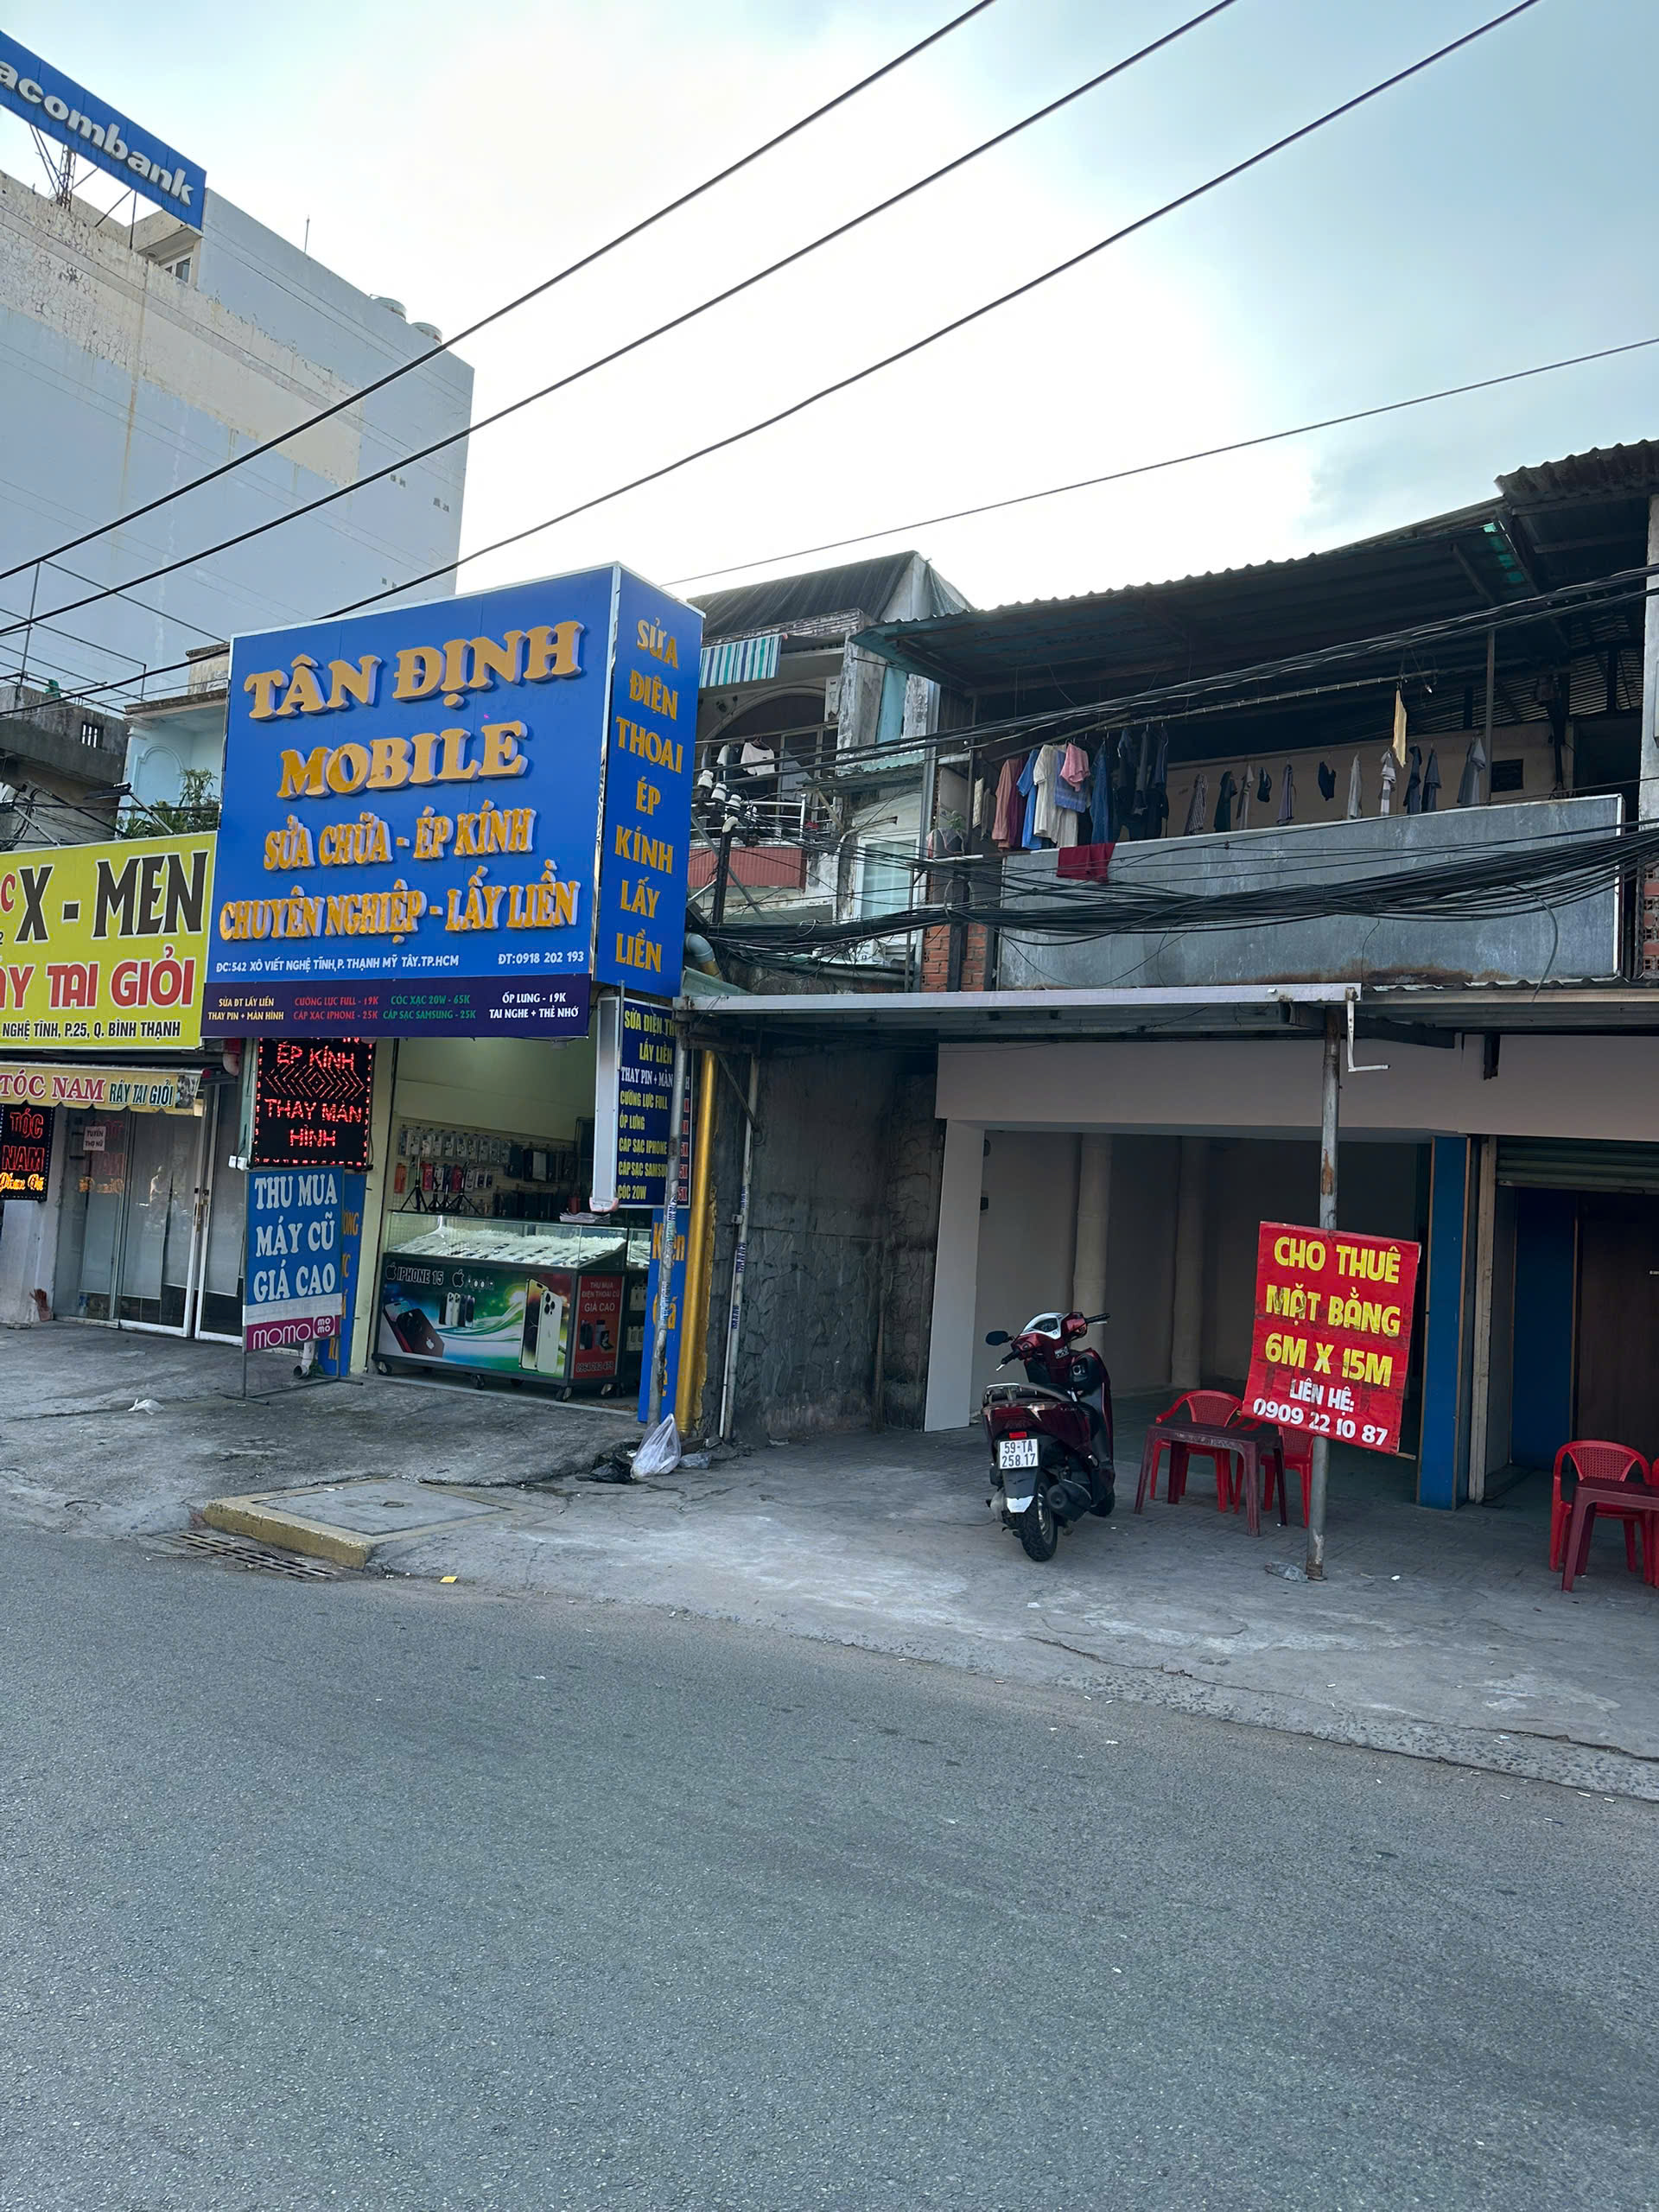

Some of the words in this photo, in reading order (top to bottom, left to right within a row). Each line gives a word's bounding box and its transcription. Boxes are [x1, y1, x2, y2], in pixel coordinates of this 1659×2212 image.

[637, 617, 678, 670] SỬA
[244, 653, 382, 721] TÂN
[392, 620, 585, 709] ĐỊNH
[629, 669, 678, 721] ĐIỆN
[276, 720, 528, 800] MOBILE
[616, 715, 683, 774] THOẠI
[636, 776, 660, 816] ÉP
[264, 814, 315, 871] SỬA
[319, 811, 393, 866] CHỮA
[413, 805, 454, 860] ÉP
[454, 799, 537, 855] KÍNH
[614, 824, 674, 874] KÍNH
[15, 865, 53, 942] X
[92, 850, 209, 938] MEN
[219, 885, 326, 941] CHUYÊN
[325, 879, 427, 944] NGHIỆP
[445, 865, 507, 932] LẤY
[506, 859, 581, 929] LIỀN
[620, 876, 660, 919] LẤY
[250, 959, 263, 971] XÔ
[264, 957, 284, 971] VIẾT
[286, 957, 311, 972] NGHỆ
[346, 957, 380, 971] THẠNH
[383, 955, 397, 968] MỸ
[543, 952, 563, 963] 202
[567, 951, 584, 963] 193
[615, 928, 662, 973] LIỀN
[47, 963, 99, 1008] TAI
[111, 944, 196, 1007] GIỎI
[340, 996, 356, 1005] FULL
[429, 995, 446, 1004] 20W
[489, 1009, 502, 1019] TAI
[505, 1008, 529, 1018] NGHE
[539, 1005, 556, 1018] THẺ
[557, 1006, 579, 1017] NHỚ
[502, 991, 515, 1003] ỐP
[550, 993, 567, 1002] 19K
[3, 1020, 30, 1040] NGHỆ
[94, 1023, 105, 1037] Q.
[108, 1019, 137, 1037] BÌNH
[140, 1021, 181, 1040] THẠNH
[327, 1011, 355, 1020] IPHONE
[416, 1010, 453, 1019] SAMSUNG
[461, 1010, 476, 1019] 25K
[276, 1041, 302, 1064] ÉP
[309, 1046, 354, 1071] KÍNH
[639, 1038, 654, 1062] LẤY
[0, 1069, 44, 1096] TÓC
[52, 1077, 105, 1100] NAM
[110, 1079, 130, 1103] RÁY
[132, 1084, 148, 1103] TAI
[149, 1079, 175, 1106] GIỎI
[621, 1066, 639, 1084] THAY
[641, 1070, 652, 1085] PIN
[264, 1098, 317, 1120] THAY
[655, 1095, 668, 1109] FULL
[10, 1108, 44, 1139] TÓC
[2, 1145, 45, 1172] NAM
[646, 1141, 667, 1155] IPHONE
[255, 1175, 293, 1210] THU
[297, 1173, 338, 1207] MUA
[632, 1185, 646, 1200] 20W
[256, 1215, 302, 1257] MÁY
[308, 1211, 335, 1252] CŨ
[1274, 1236, 1326, 1271] CHO
[1336, 1245, 1402, 1284] THUÊ
[253, 1259, 290, 1303] GIÁ
[296, 1263, 335, 1297] CAO
[397, 1267, 431, 1284] IPHONE
[432, 1270, 444, 1286] 15
[599, 1302, 615, 1313] CAO
[1266, 1283, 1321, 1325] MẶT
[1328, 1287, 1401, 1338] BẰNG
[253, 1323, 311, 1350] momo
[1265, 1333, 1307, 1369] 6M
[1313, 1341, 1334, 1374] X
[1341, 1348, 1393, 1388] 15M
[1289, 1377, 1324, 1405] LIÊN
[1327, 1386, 1355, 1415] HỆ:
[1253, 1398, 1304, 1425] 0909
[1308, 1411, 1331, 1433] 22
[1336, 1418, 1356, 1439] 10
[1361, 1424, 1388, 1446] 87
[1002, 1453, 1036, 1467] 258.17
[1005, 1440, 1033, 1453] 59-TA
